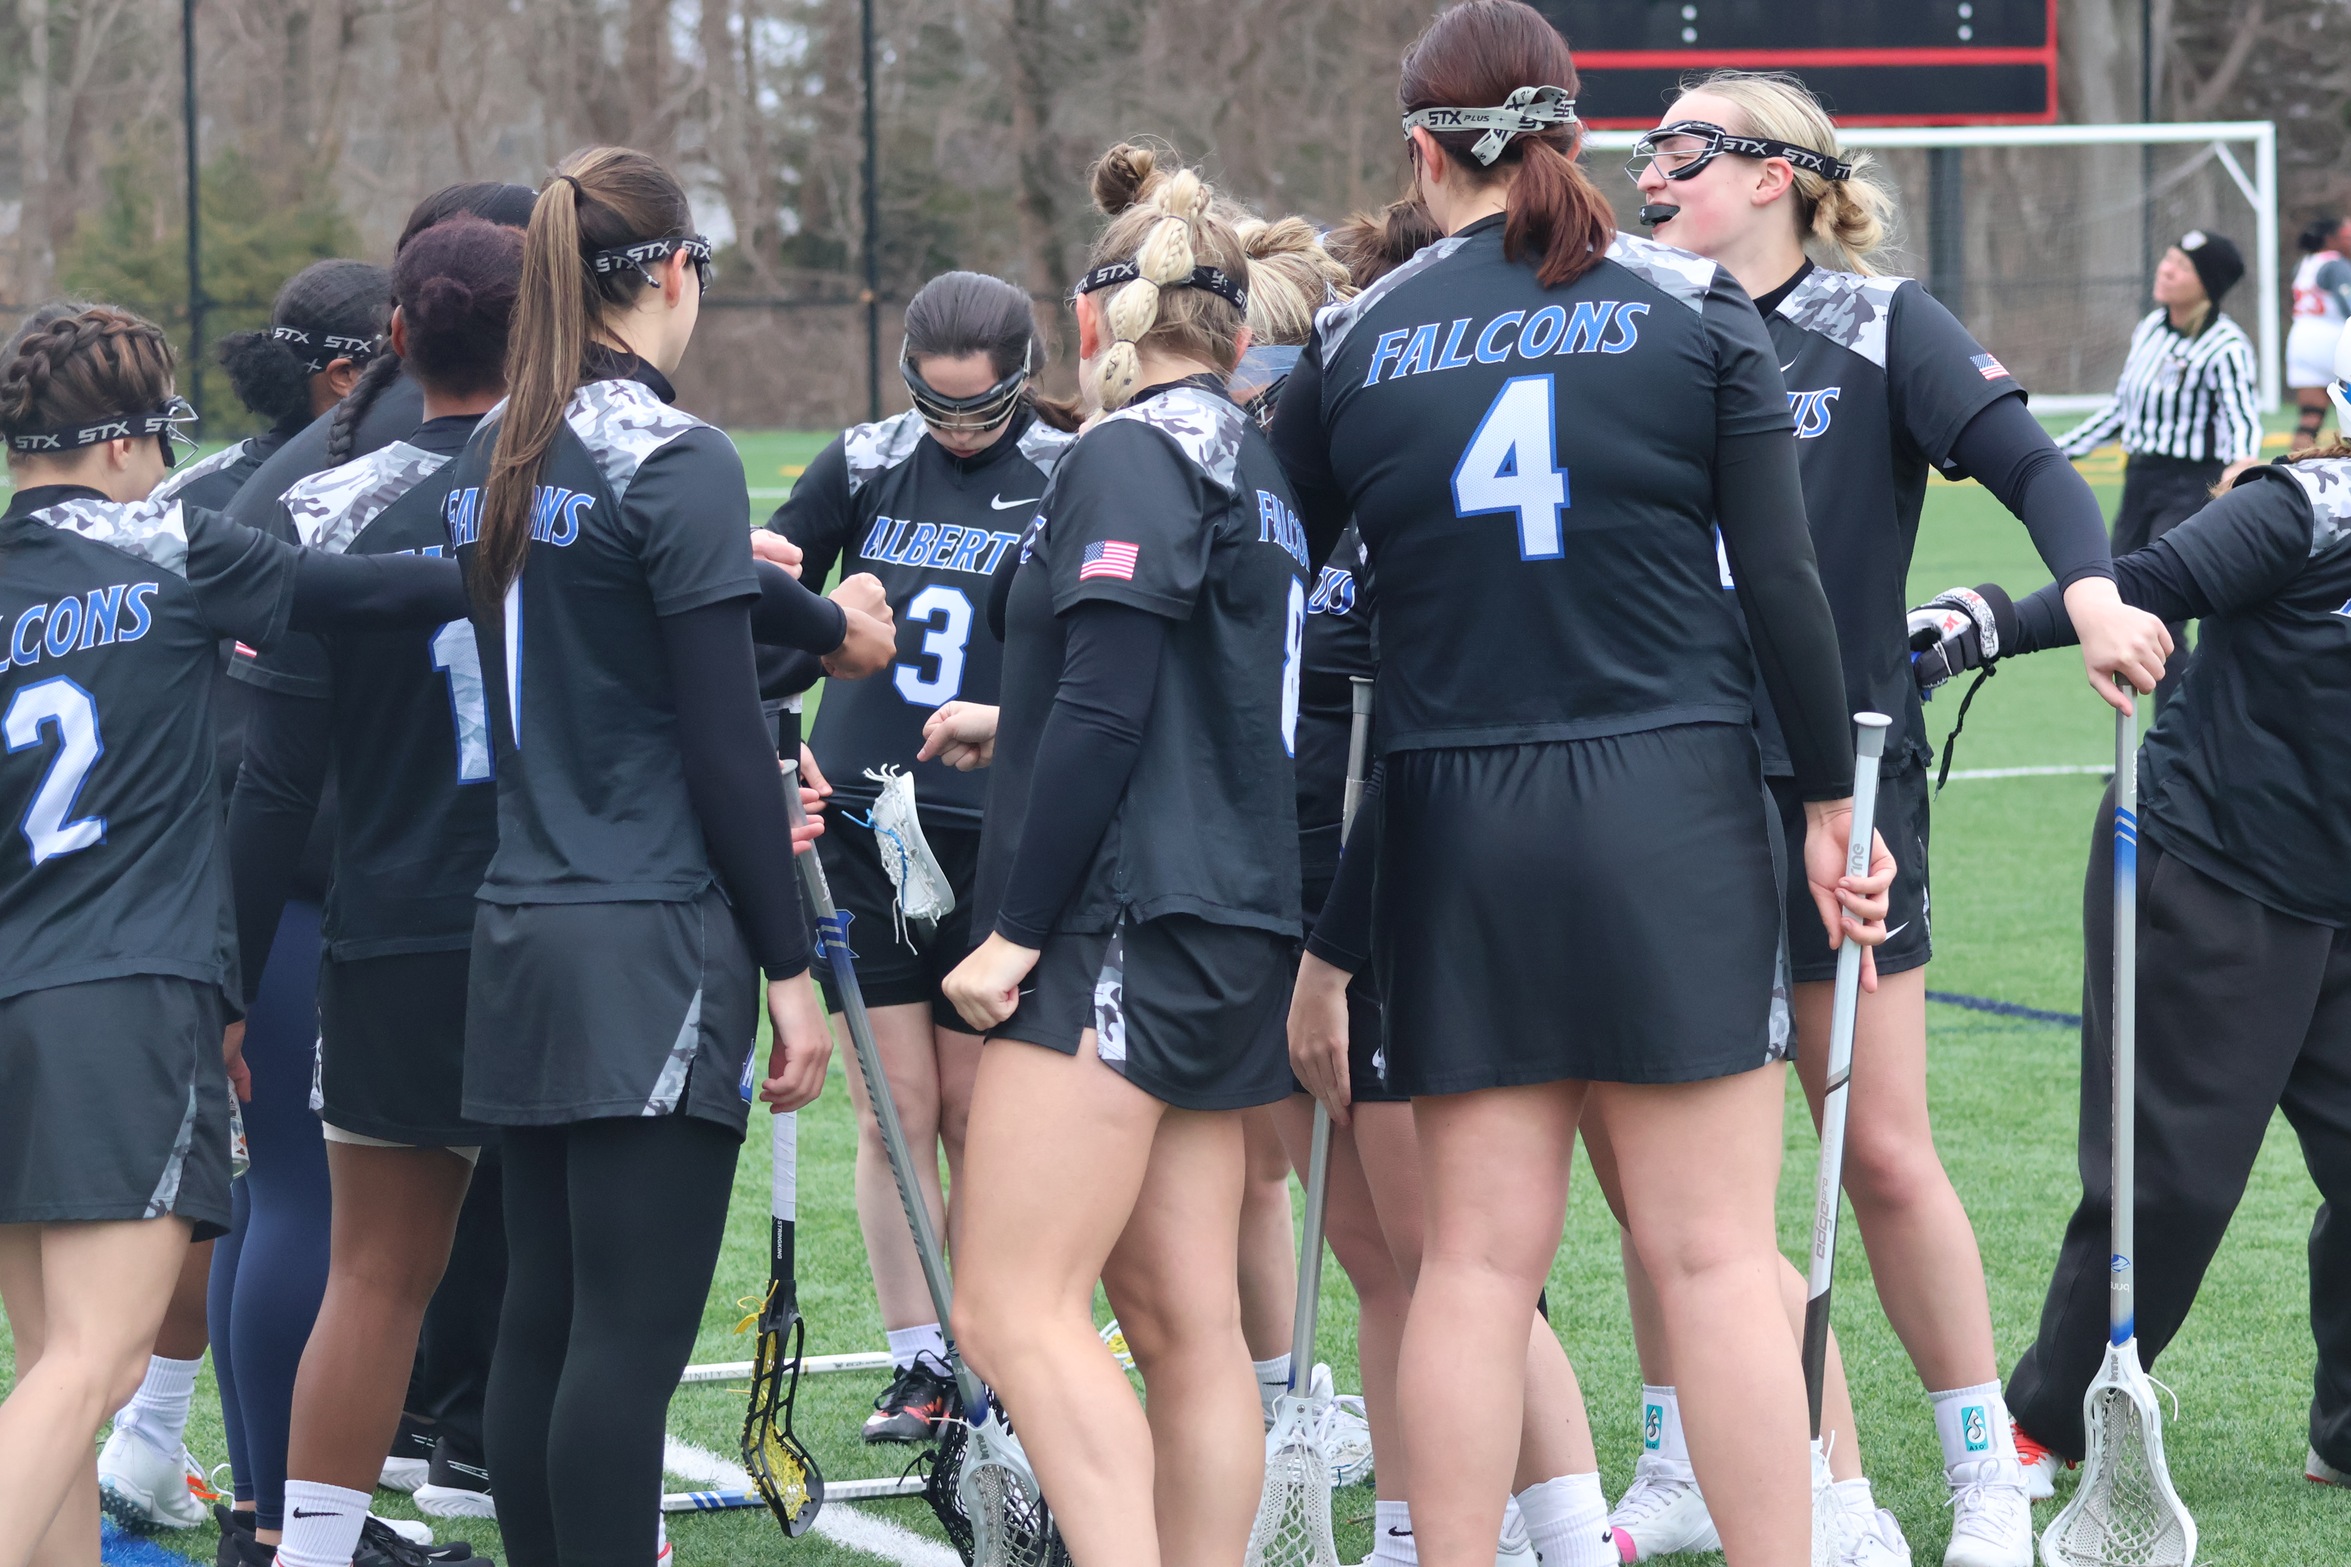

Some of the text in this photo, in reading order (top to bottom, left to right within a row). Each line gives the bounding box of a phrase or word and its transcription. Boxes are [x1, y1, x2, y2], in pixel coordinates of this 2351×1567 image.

[1428, 110, 1462, 126] STX
[1463, 114, 1491, 123] PLUS
[1722, 136, 1769, 156] STX
[1781, 147, 1824, 171] STX
[626, 240, 673, 263] STX
[1095, 261, 1135, 284] STX
[273, 327, 372, 353] STX STX
[1362, 301, 1650, 389] FALCONS
[14, 417, 173, 449] STX STX ST
[1449, 373, 1571, 562] 4
[0, 582, 159, 674] CONS
[892, 583, 975, 709] 3
[1, 674, 108, 867] 2
[1851, 844, 1864, 877] rine
[681, 1370, 722, 1381] FINITY
